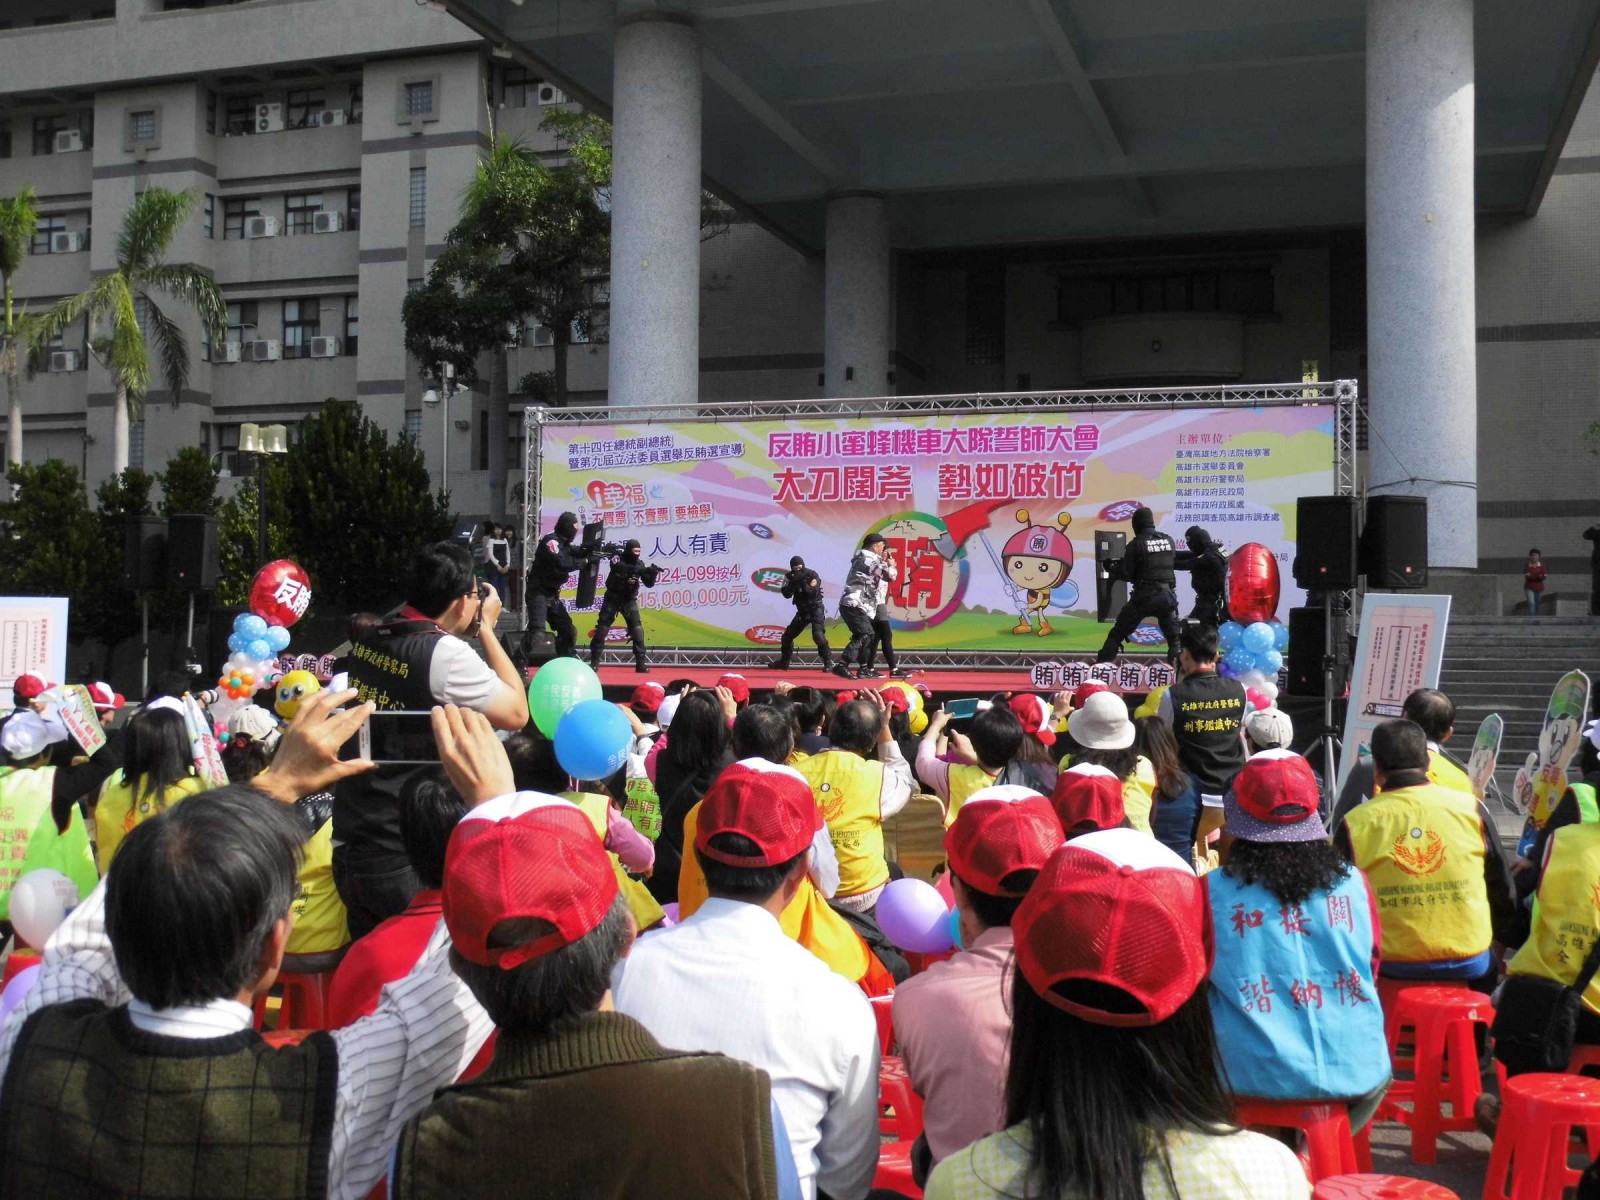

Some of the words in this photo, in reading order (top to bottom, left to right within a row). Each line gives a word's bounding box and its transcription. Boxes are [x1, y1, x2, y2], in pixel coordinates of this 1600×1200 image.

[568, 435, 673, 456] 第十四任總統副總統
[768, 425, 1099, 457] 反賄小蜜蜂機車大隊誓師大會
[568, 443, 743, 469] 暨第九屆立法委員選舉反賄選宣導
[1175, 448, 1271, 458] 臺灣高雄地方法院檢察署
[1175, 462, 1244, 471] 高雄市選舉委員會
[773, 465, 911, 501] 大刀闊斧
[939, 462, 1085, 498] 勢如破竹
[1175, 475, 1244, 484] 高雄市政府警察局
[1175, 488, 1244, 497] 高雄市政府民政局
[591, 510, 626, 525] 不買票
[633, 507, 669, 522] 不賣票
[675, 503, 712, 520] 要檢舉
[1175, 501, 1244, 509] 高雄市政府政風處
[1175, 513, 1280, 522] 法務部調查局高雄市調查處
[649, 533, 728, 558] 人人有責
[273, 576, 312, 618] 反賄
[1035, 666, 1054, 686] 賄
[1062, 666, 1082, 686] 賄
[1120, 667, 1140, 687] 賄
[1148, 668, 1168, 687] 賄
[1182, 699, 1241, 711] 高雄市政府警察局
